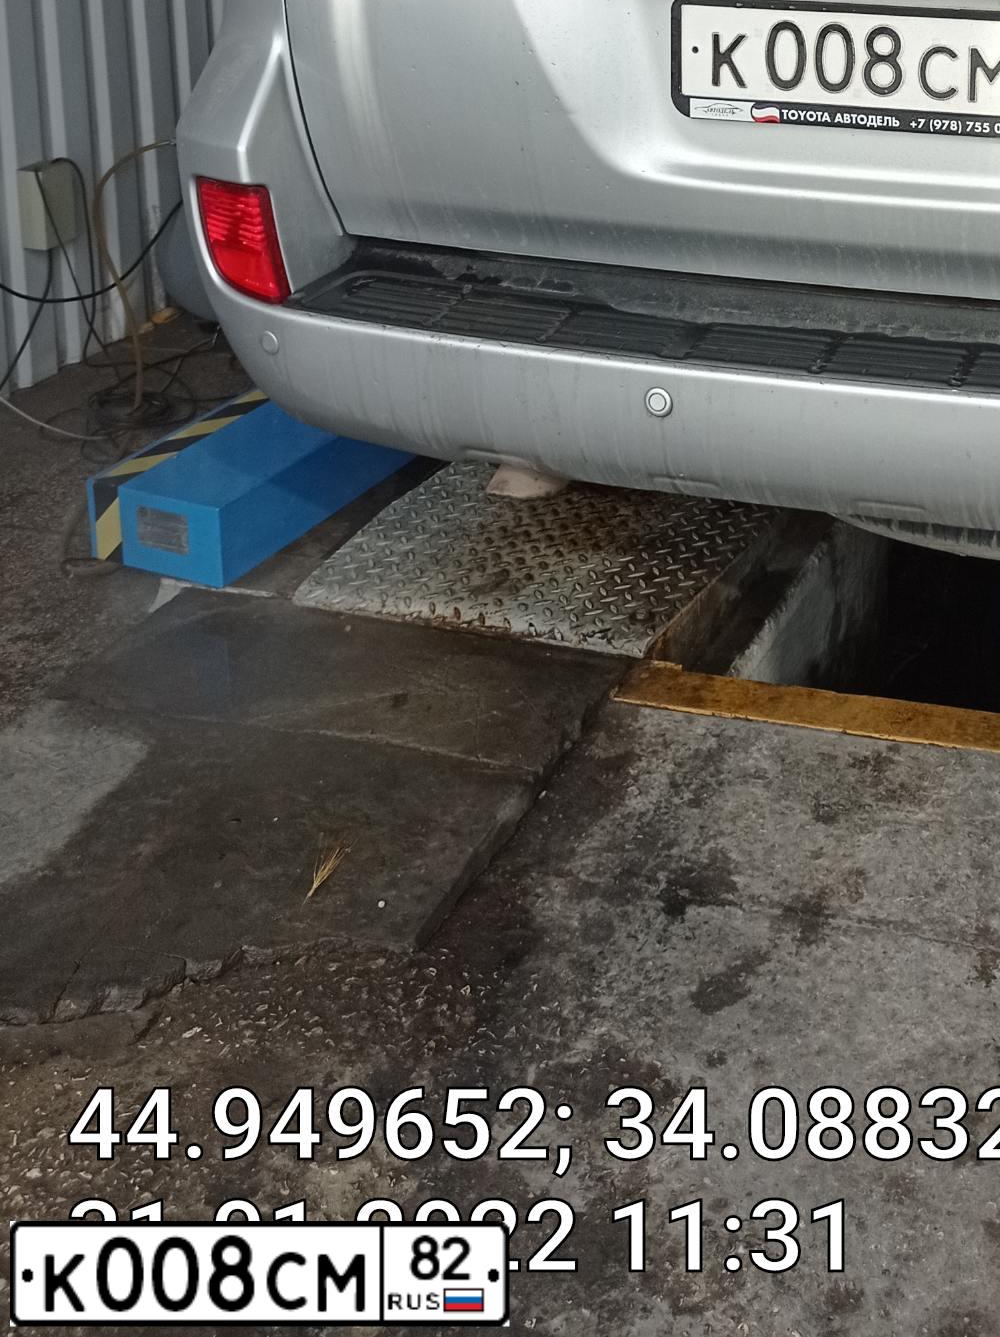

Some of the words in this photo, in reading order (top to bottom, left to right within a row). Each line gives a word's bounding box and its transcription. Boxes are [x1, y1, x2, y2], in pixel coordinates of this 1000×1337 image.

[781, 108, 831, 123] TOYOTA
[834, 112, 900, 128] АВТОДЕЛЬ
[909, 118, 926, 129] +7
[929, 119, 962, 134] (978)
[966, 121, 990, 133] 755
